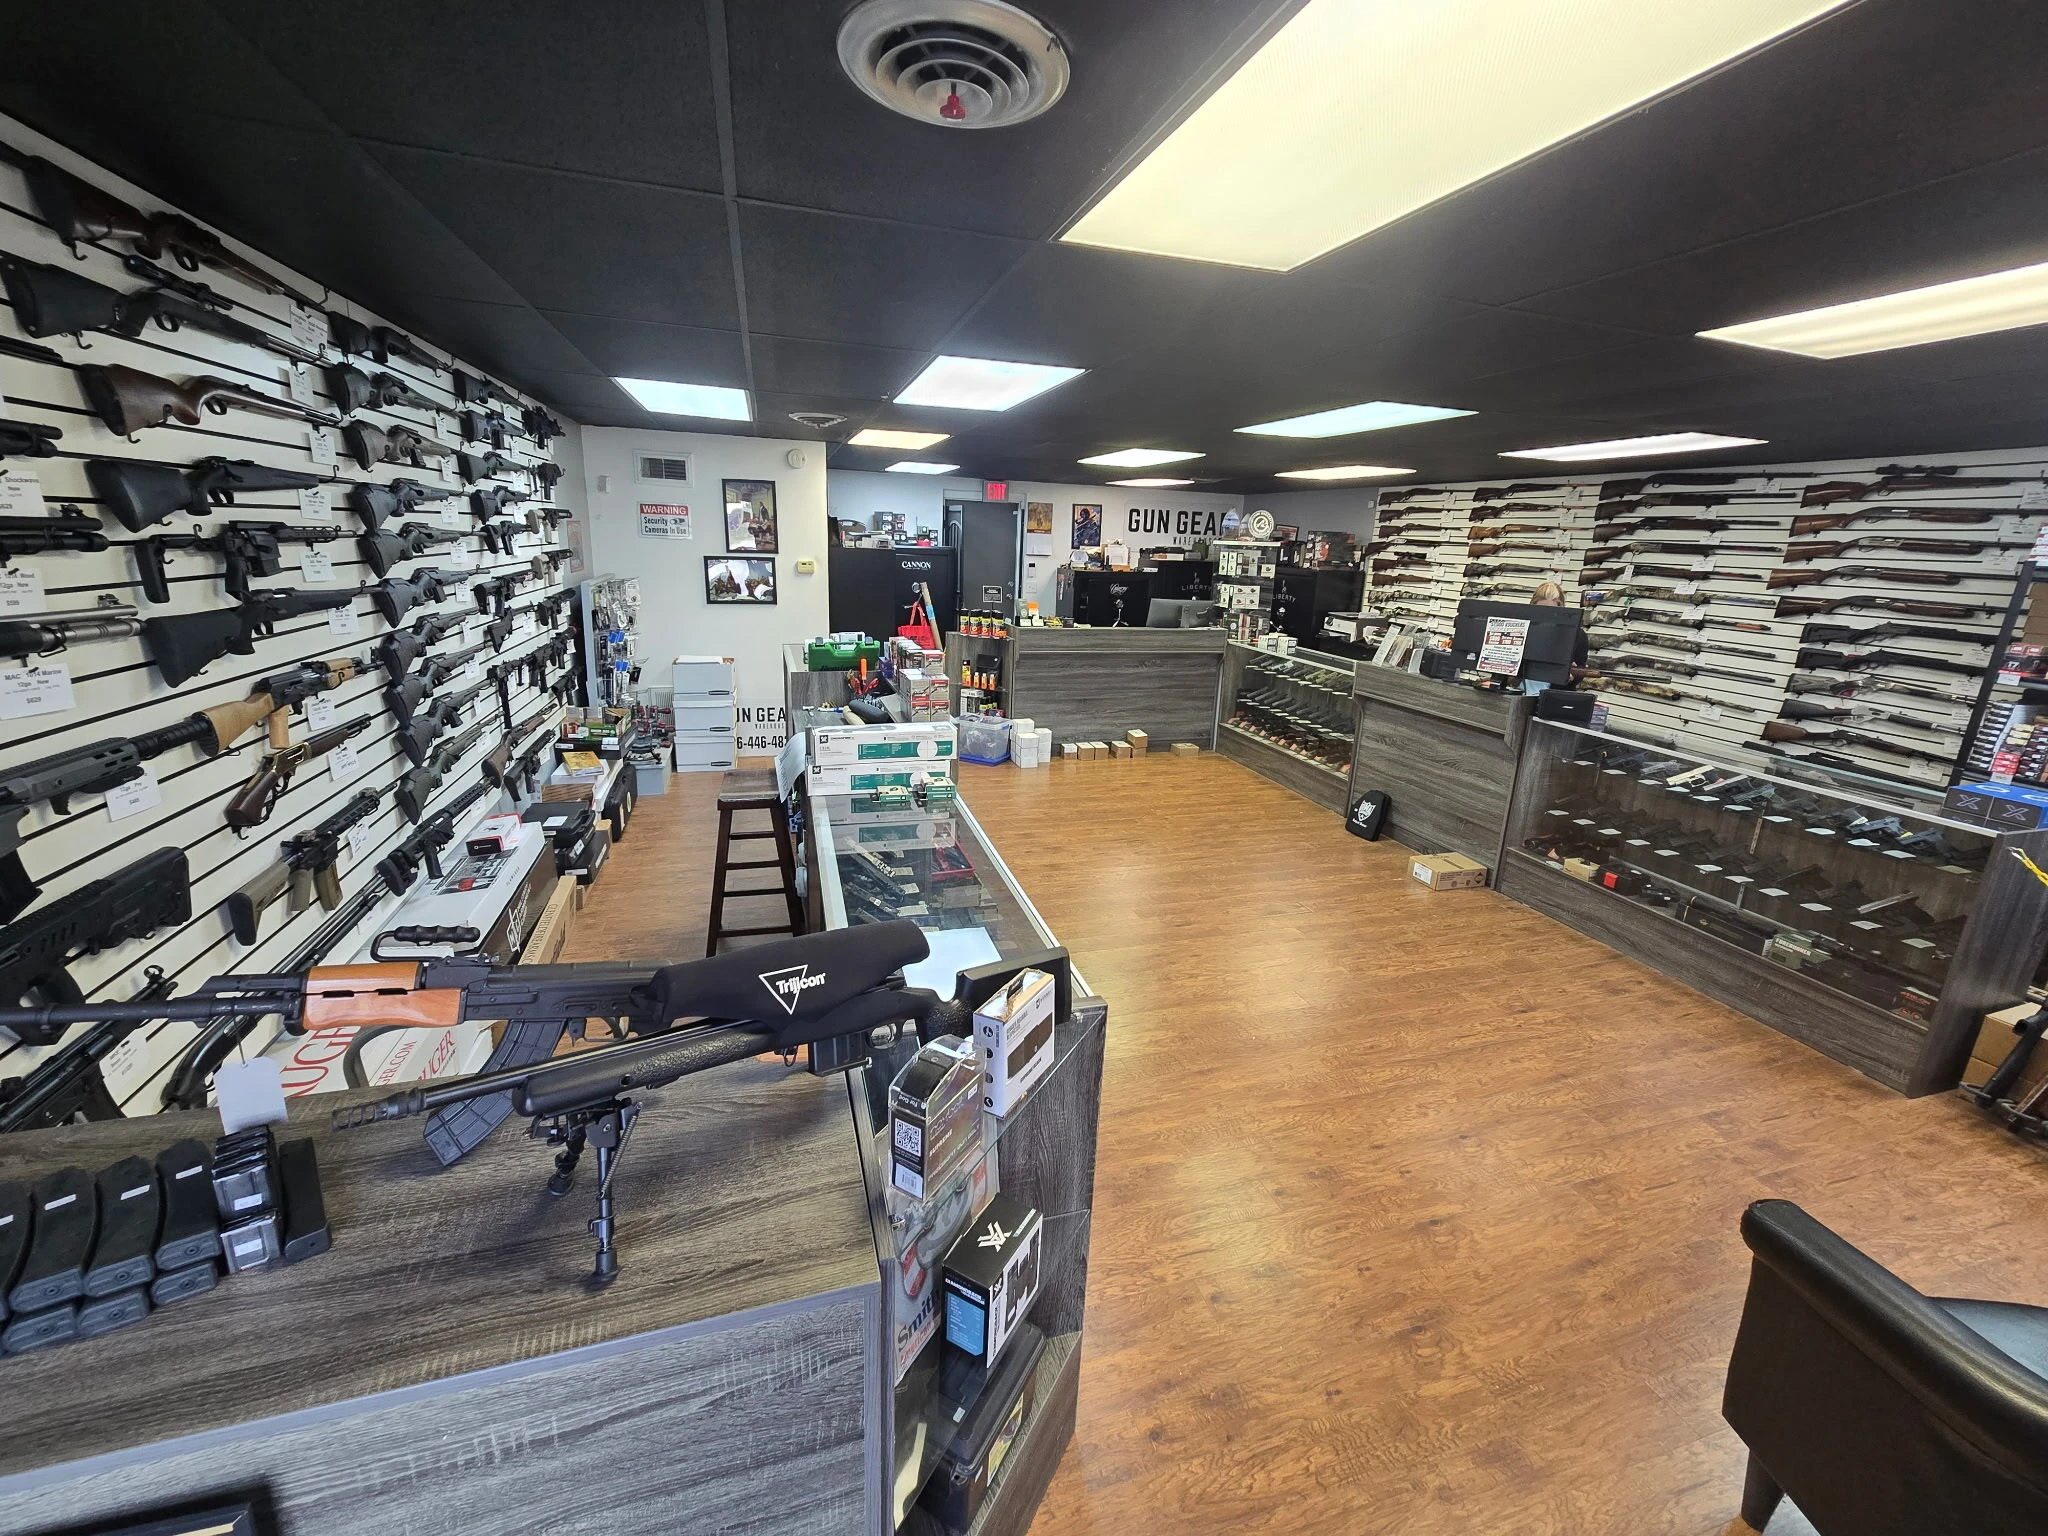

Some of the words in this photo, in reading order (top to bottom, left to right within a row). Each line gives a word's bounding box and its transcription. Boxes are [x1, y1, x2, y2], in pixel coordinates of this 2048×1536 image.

[987, 483, 1007, 500] EXIT
[642, 504, 687, 515] WARNING
[643, 516, 669, 527] Security
[1128, 508, 1170, 533] GUN
[644, 525, 669, 535] Cameras
[901, 560, 932, 569] CANNON
[1181, 584, 1212, 592] LIBERTY
[756, 707, 786, 722] GEA
[736, 735, 787, 750] 6-446-48
[776, 973, 826, 994] Trijicon
